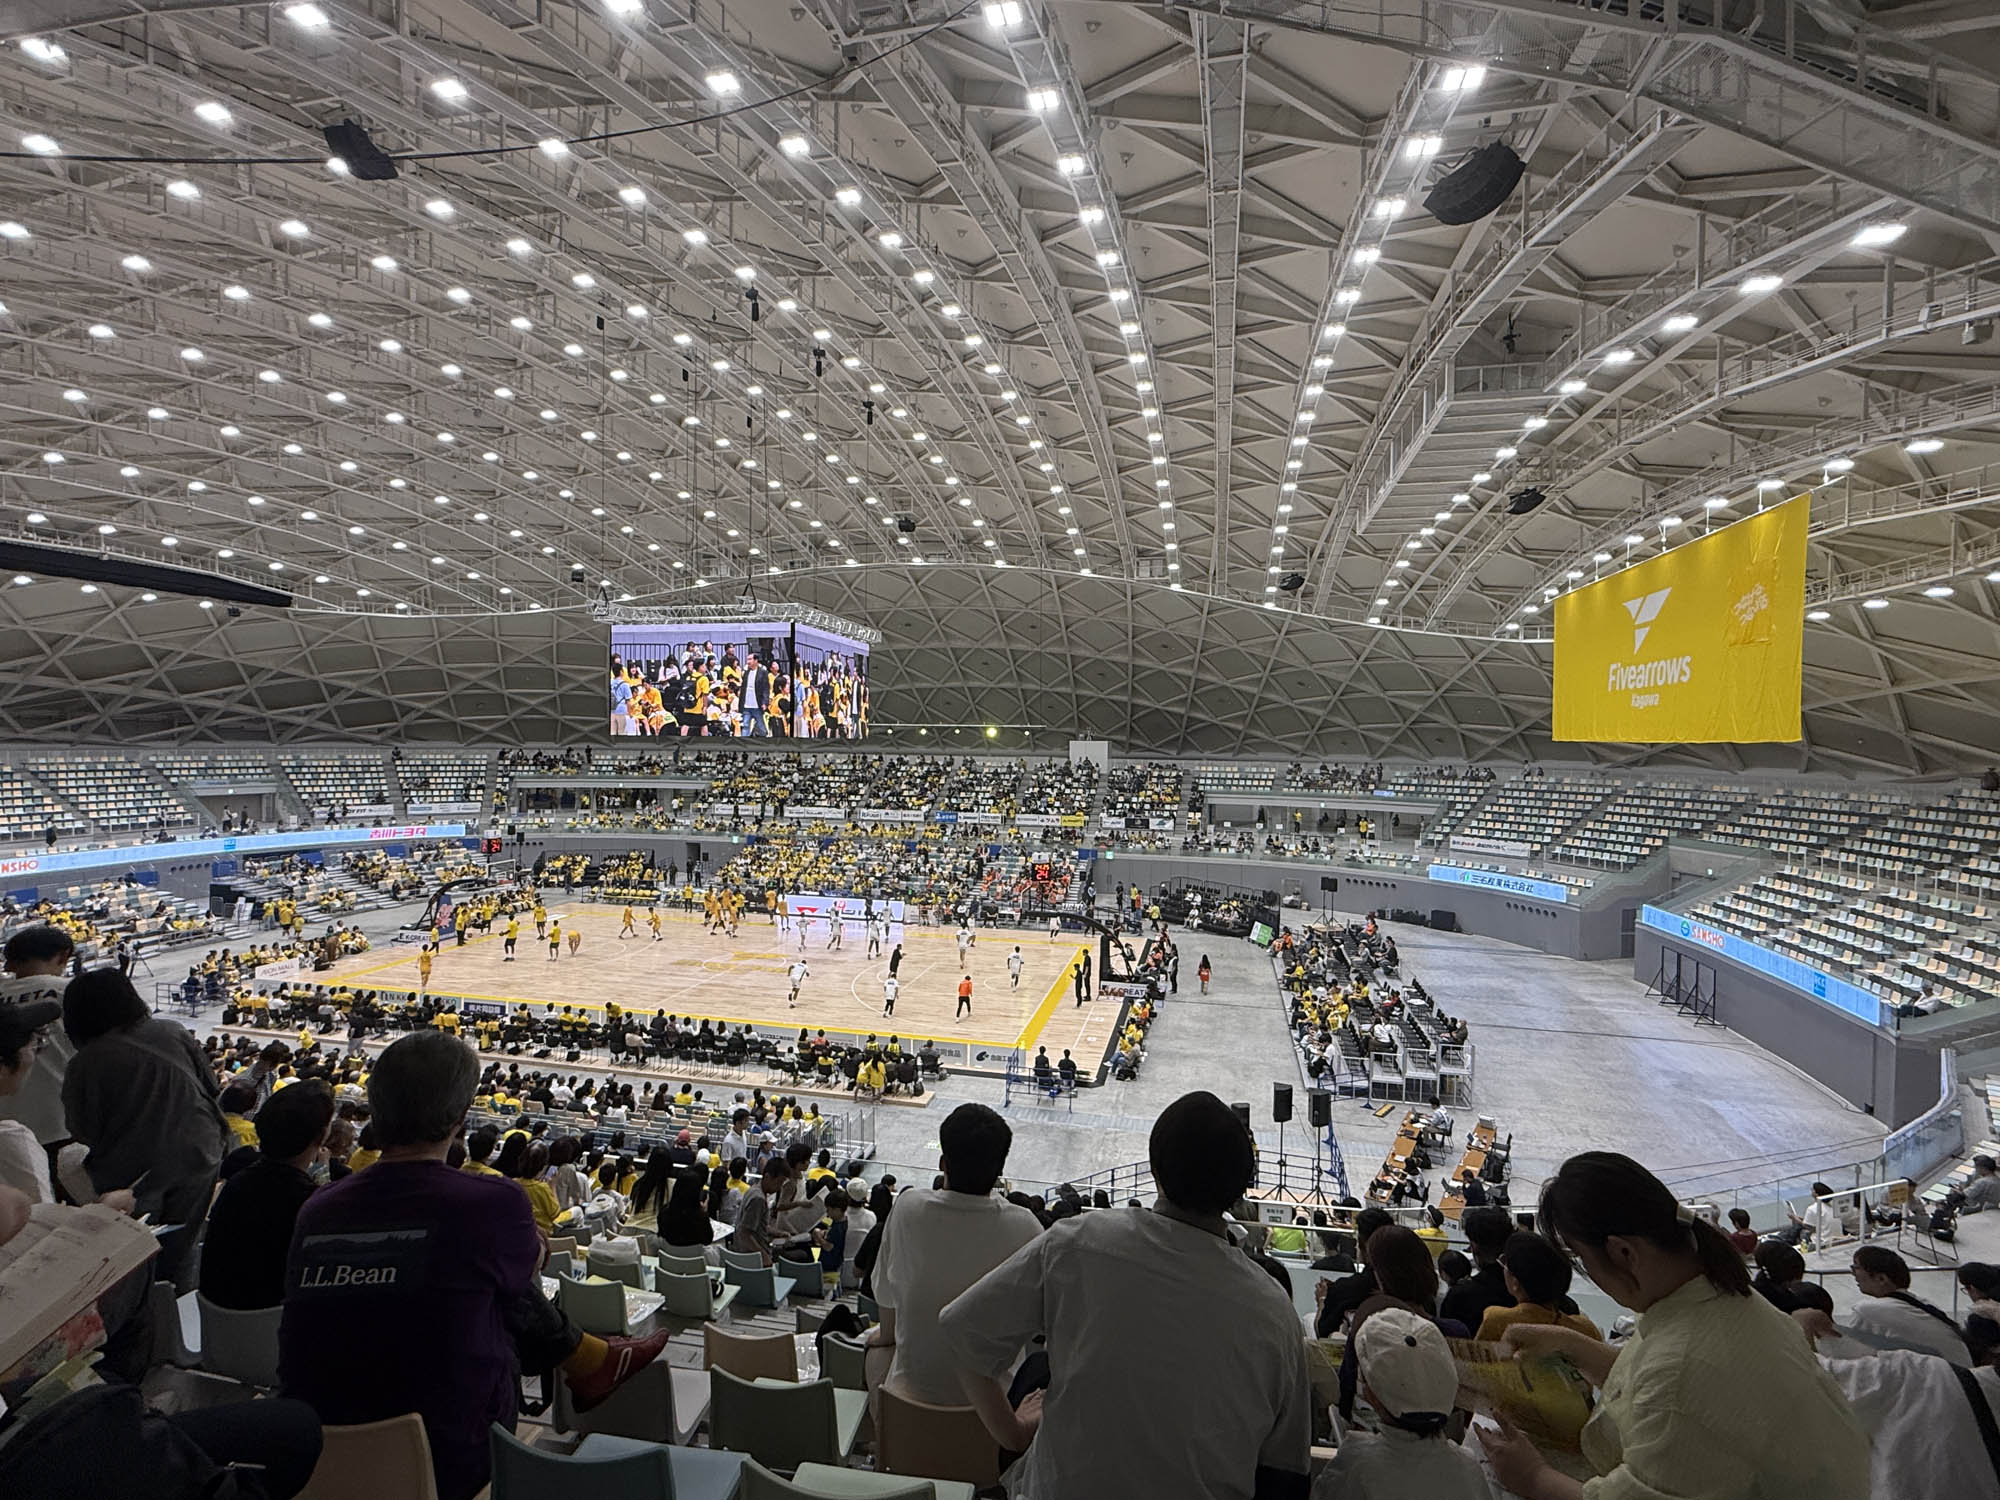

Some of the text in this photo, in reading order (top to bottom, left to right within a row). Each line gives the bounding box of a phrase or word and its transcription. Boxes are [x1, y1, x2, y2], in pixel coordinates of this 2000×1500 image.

[1608, 655, 1691, 692] Fivearrows
[1691, 924, 1725, 949] SANSHO
[300, 1265, 397, 1288] L.L.Bean
